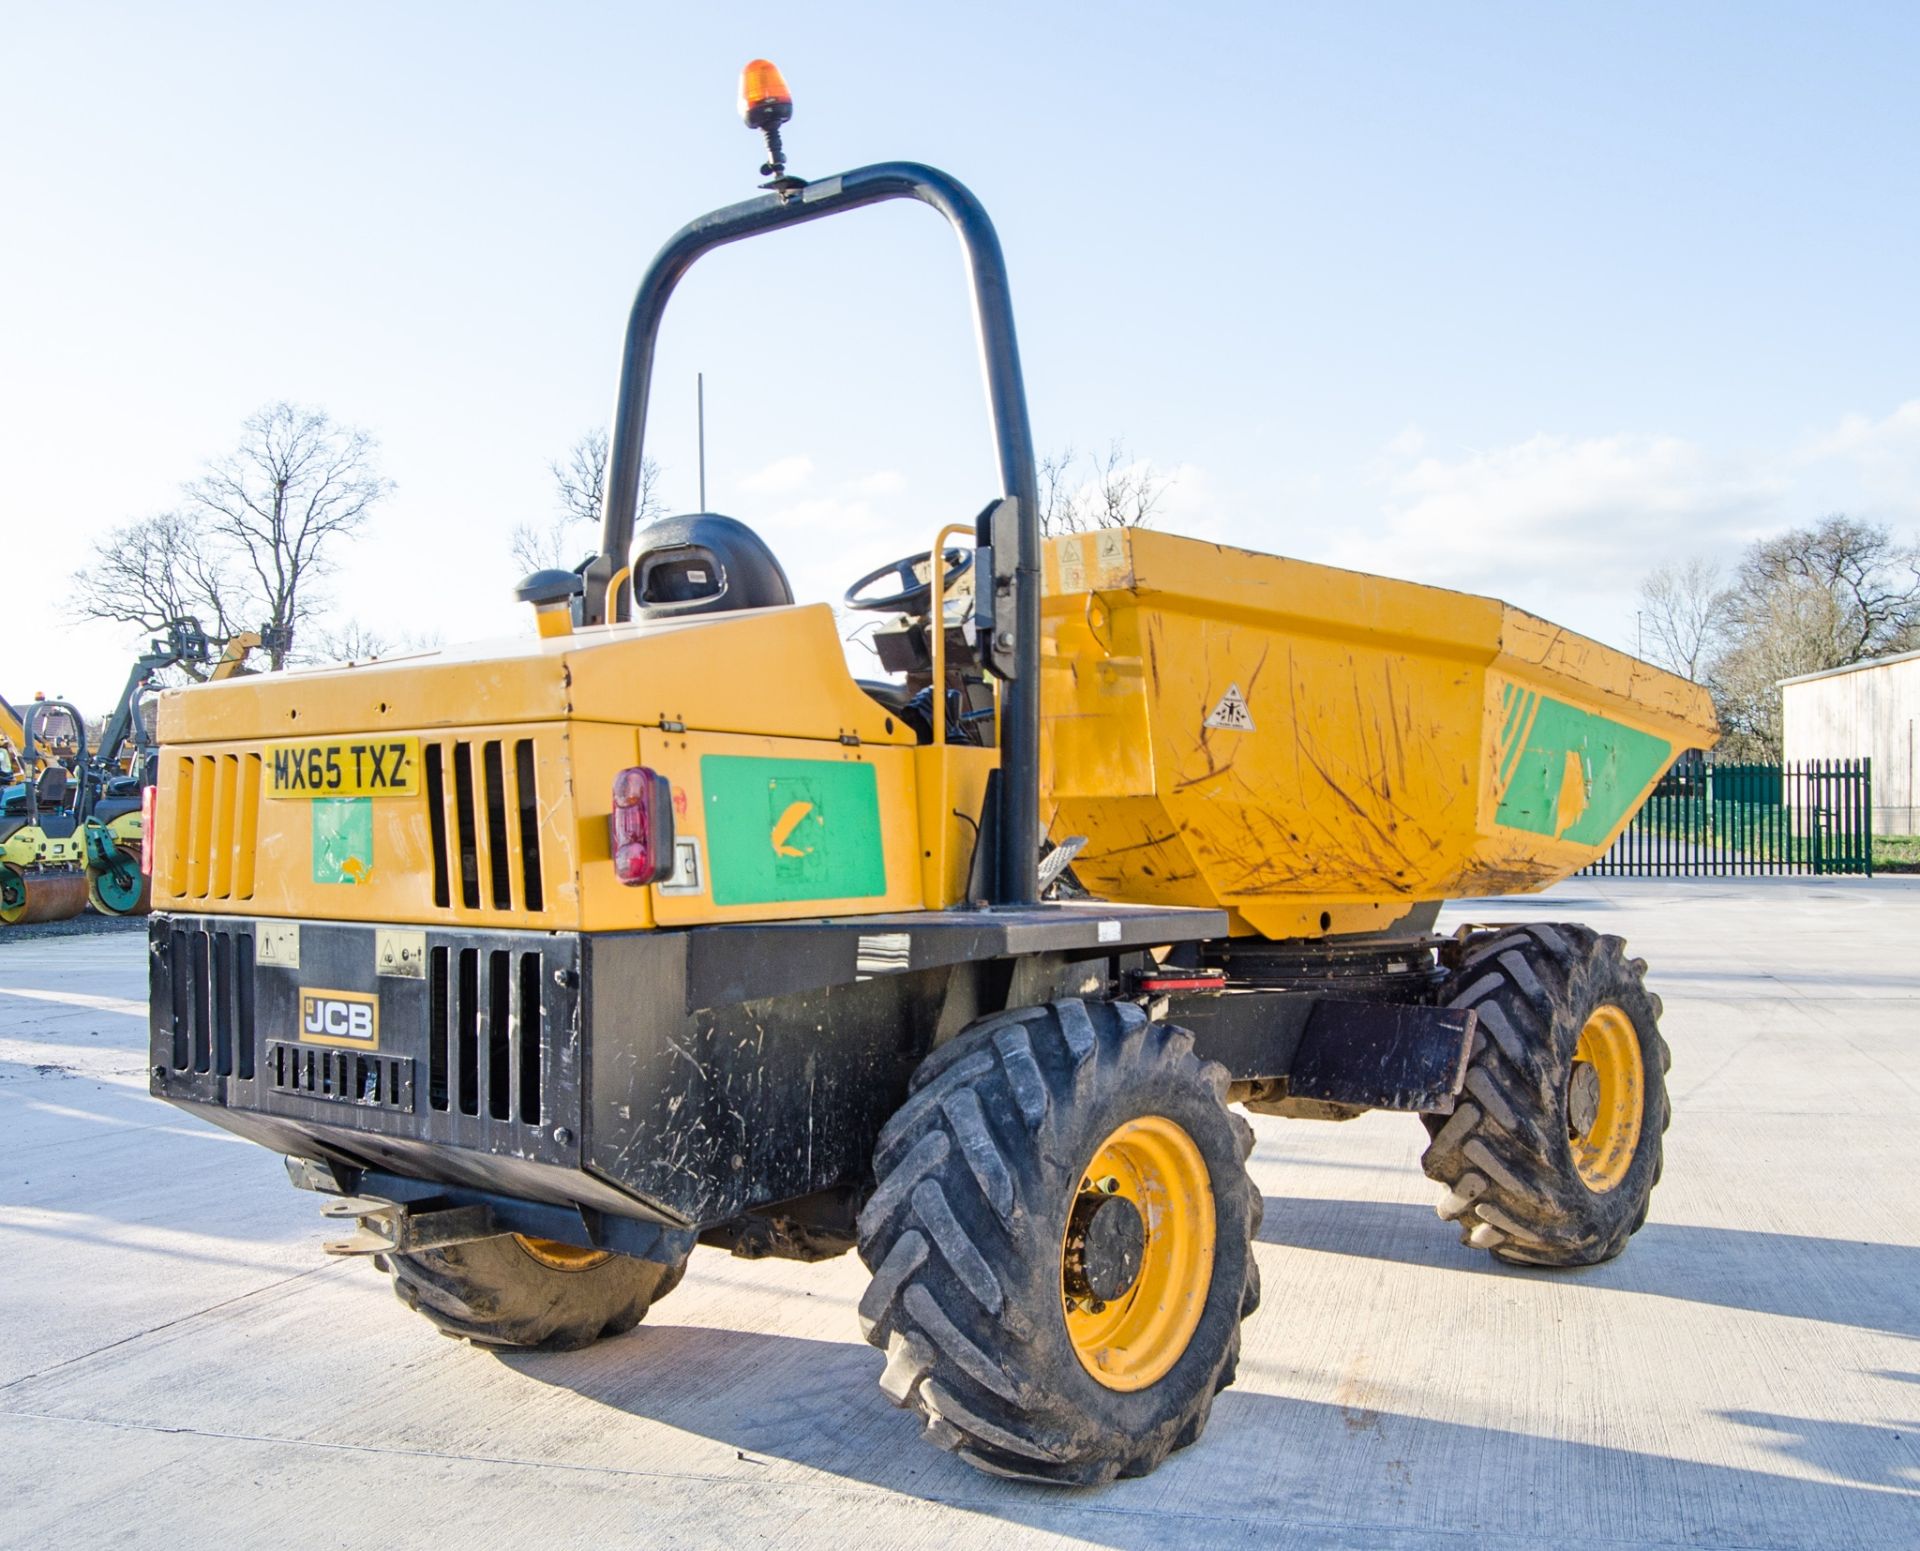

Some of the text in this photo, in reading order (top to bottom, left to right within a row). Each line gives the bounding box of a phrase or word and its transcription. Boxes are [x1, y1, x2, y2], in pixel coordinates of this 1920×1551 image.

[275, 744, 406, 789] MX65 TXZ
[305, 1000, 373, 1038] JCB
